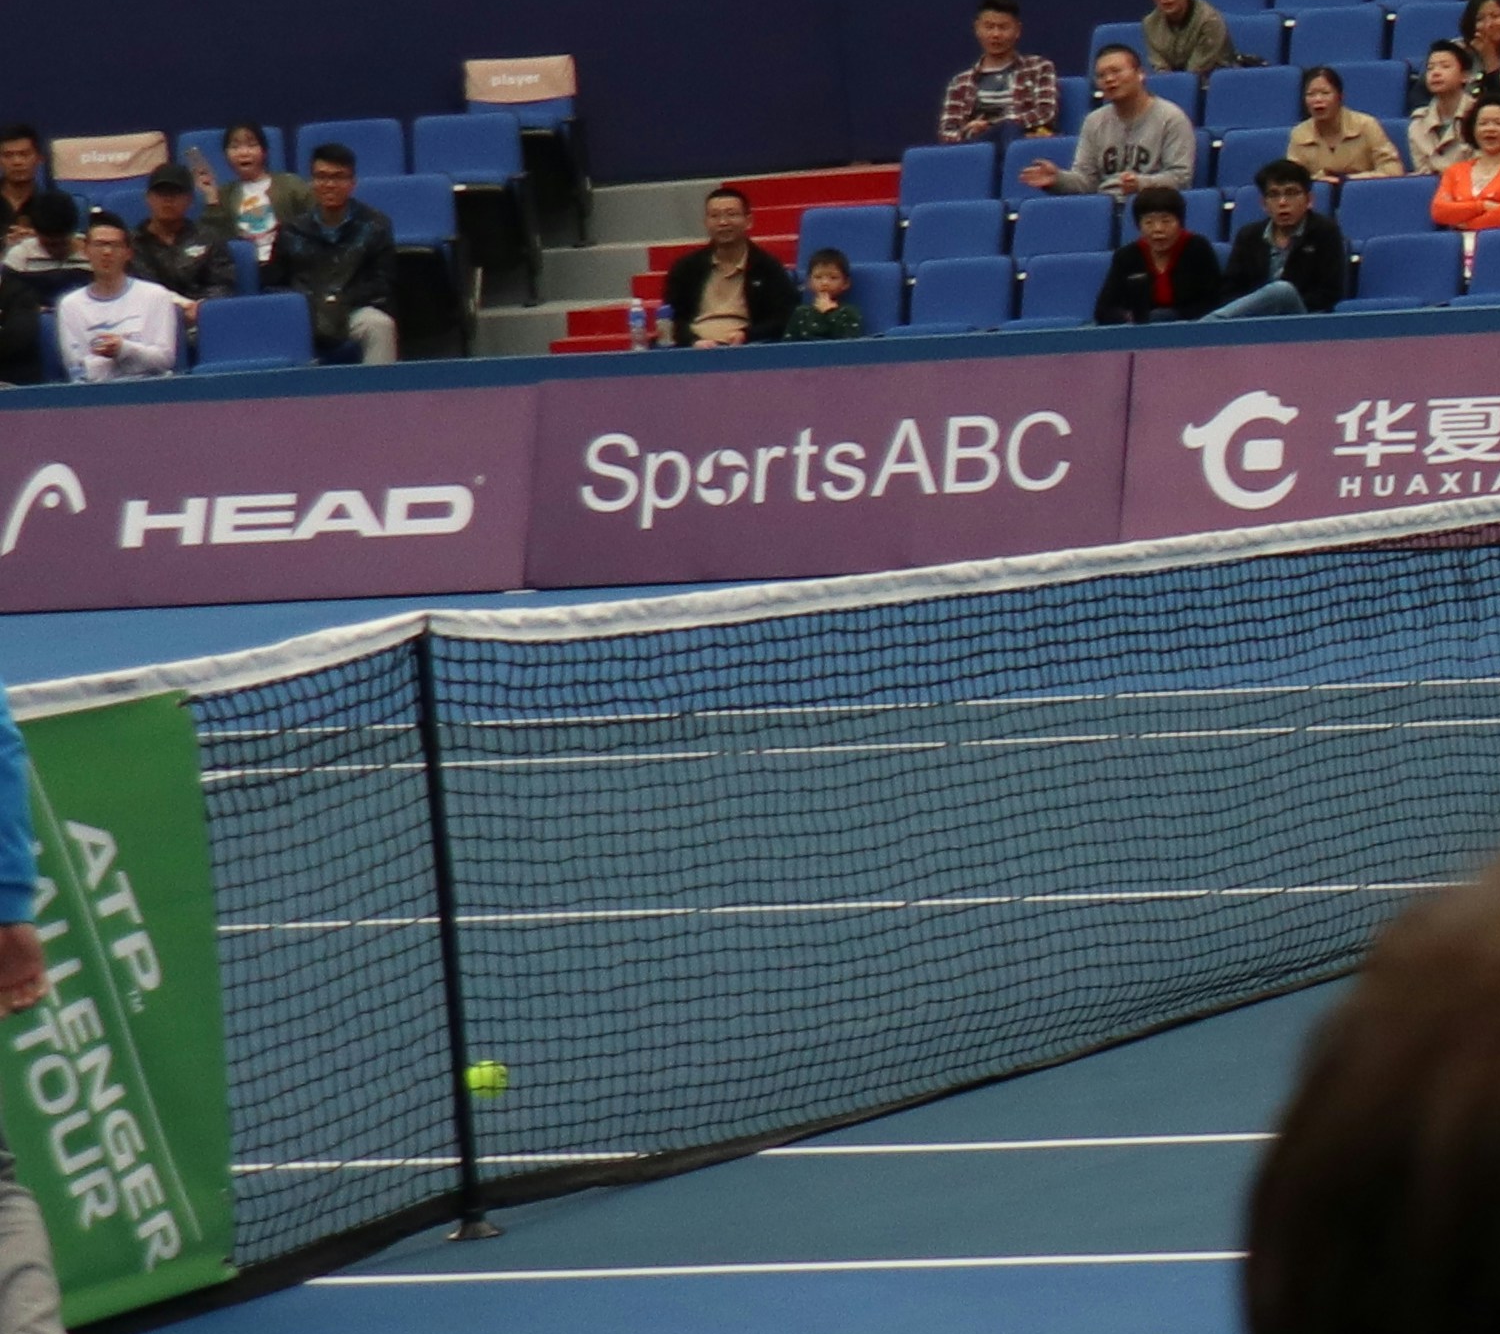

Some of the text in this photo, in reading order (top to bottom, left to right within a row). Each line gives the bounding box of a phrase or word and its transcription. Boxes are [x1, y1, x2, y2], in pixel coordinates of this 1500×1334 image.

[119, 484, 475, 548] HEAD
[580, 411, 1072, 530] SportsABC
[64, 819, 162, 992] ATP
[13, 1007, 119, 1230] TOUR
